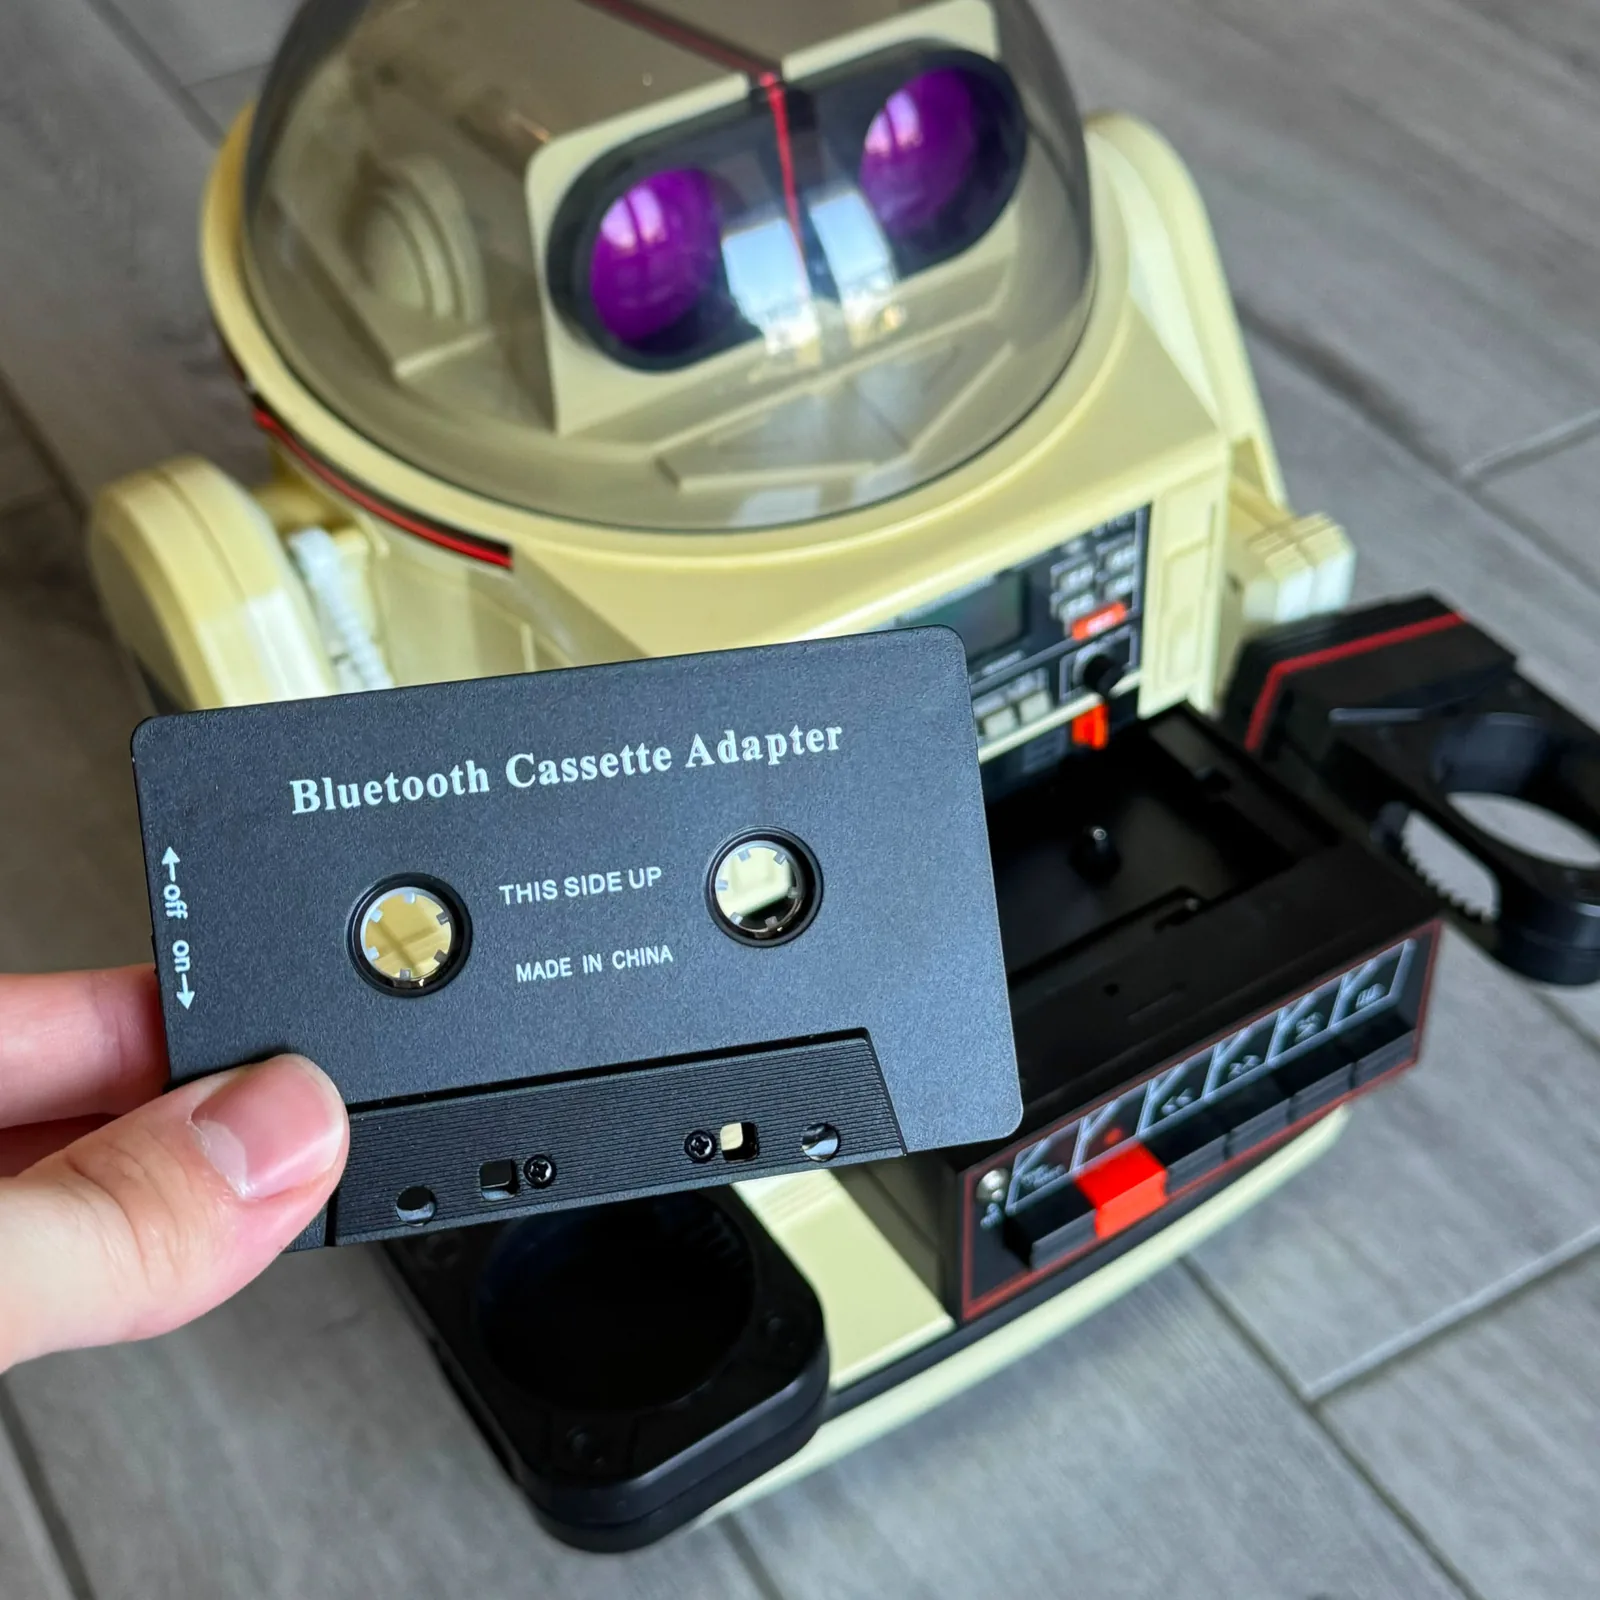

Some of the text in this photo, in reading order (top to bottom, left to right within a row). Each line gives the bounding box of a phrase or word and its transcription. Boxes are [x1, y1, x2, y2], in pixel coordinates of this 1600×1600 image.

[290, 725, 843, 815] Bluetooth Cassette Adapter
[498, 866, 662, 906] THIS SIDE UP
[163, 884, 191, 973] off on
[515, 945, 674, 983] MADE IN CHINA
